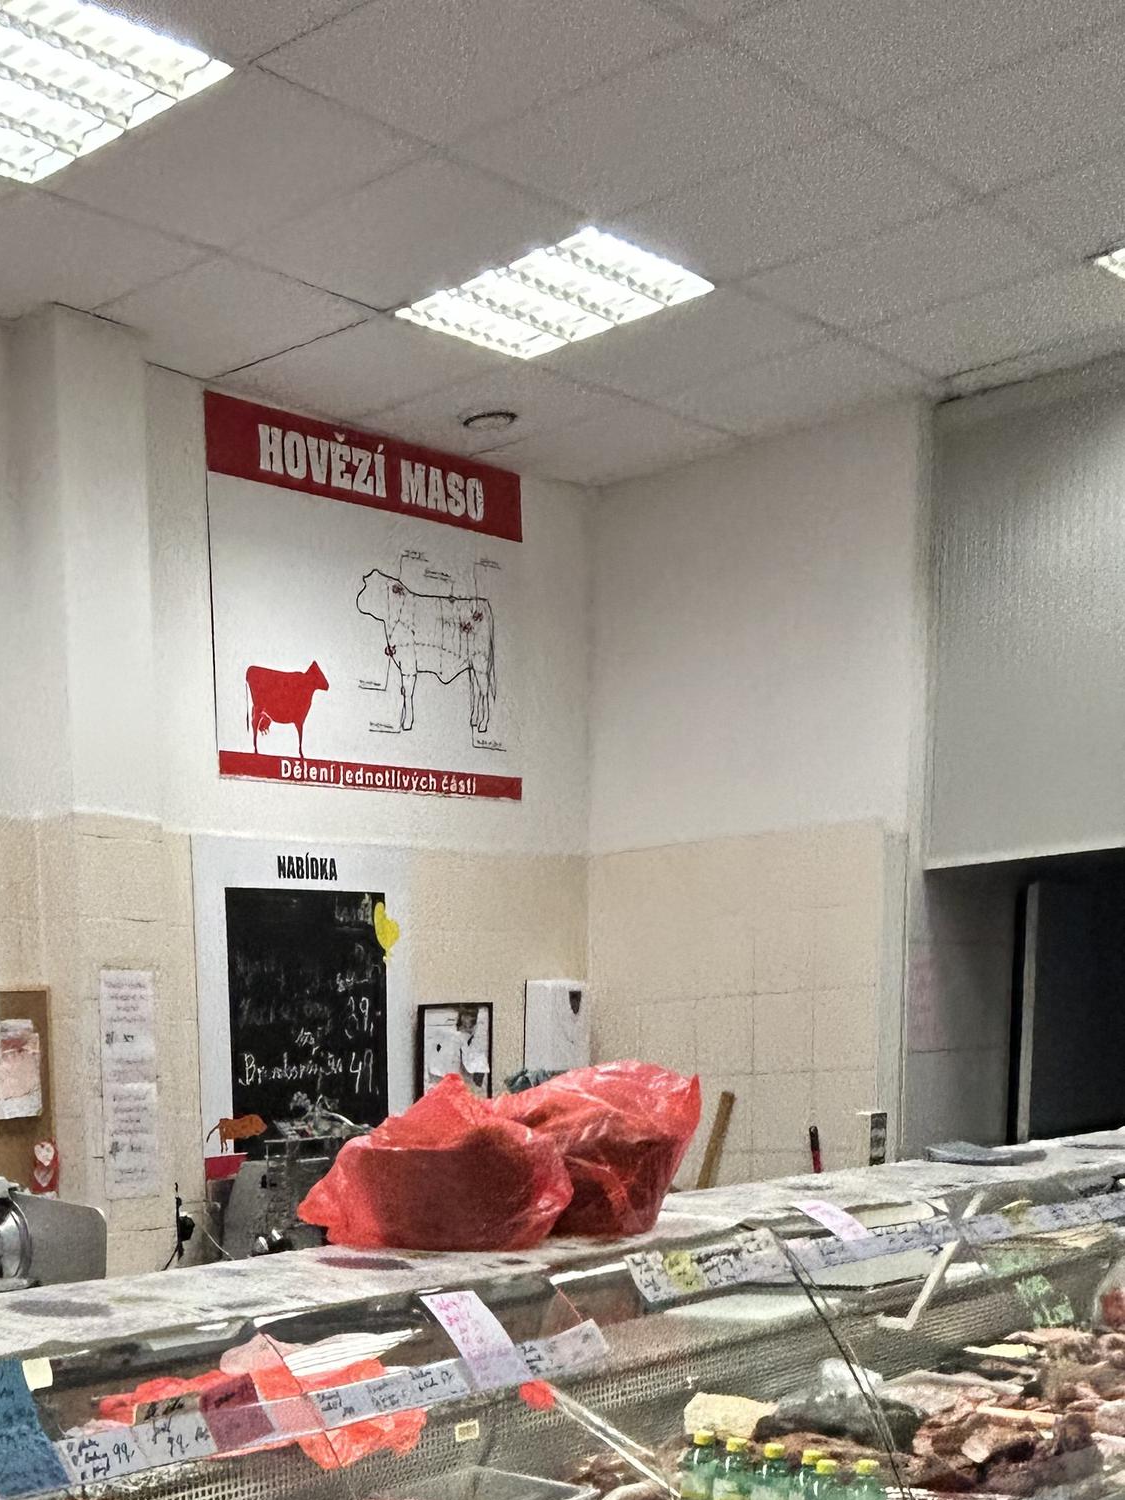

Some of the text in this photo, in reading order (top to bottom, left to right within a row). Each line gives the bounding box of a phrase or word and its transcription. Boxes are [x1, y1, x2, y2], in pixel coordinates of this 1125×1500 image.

[257, 423, 485, 523] HOVĚZÍ MASO
[338, 765, 437, 792] jednotlivých
[276, 852, 338, 882] NABÍDKA
